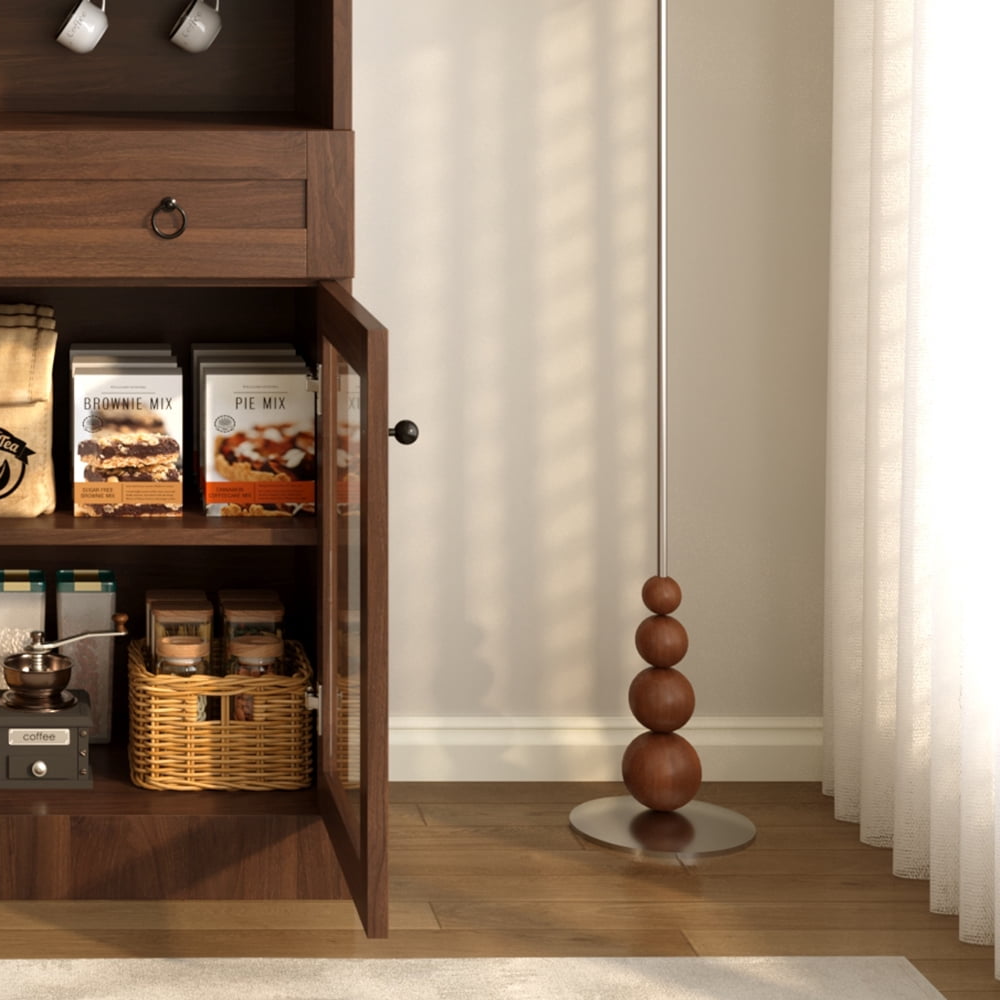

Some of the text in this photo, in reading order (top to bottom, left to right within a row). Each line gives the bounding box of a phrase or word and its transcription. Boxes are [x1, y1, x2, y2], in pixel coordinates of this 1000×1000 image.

[83, 397, 173, 410] BROWNIE MIX
[235, 397, 286, 410] PIE MIX
[22, 732, 56, 741] coffee
